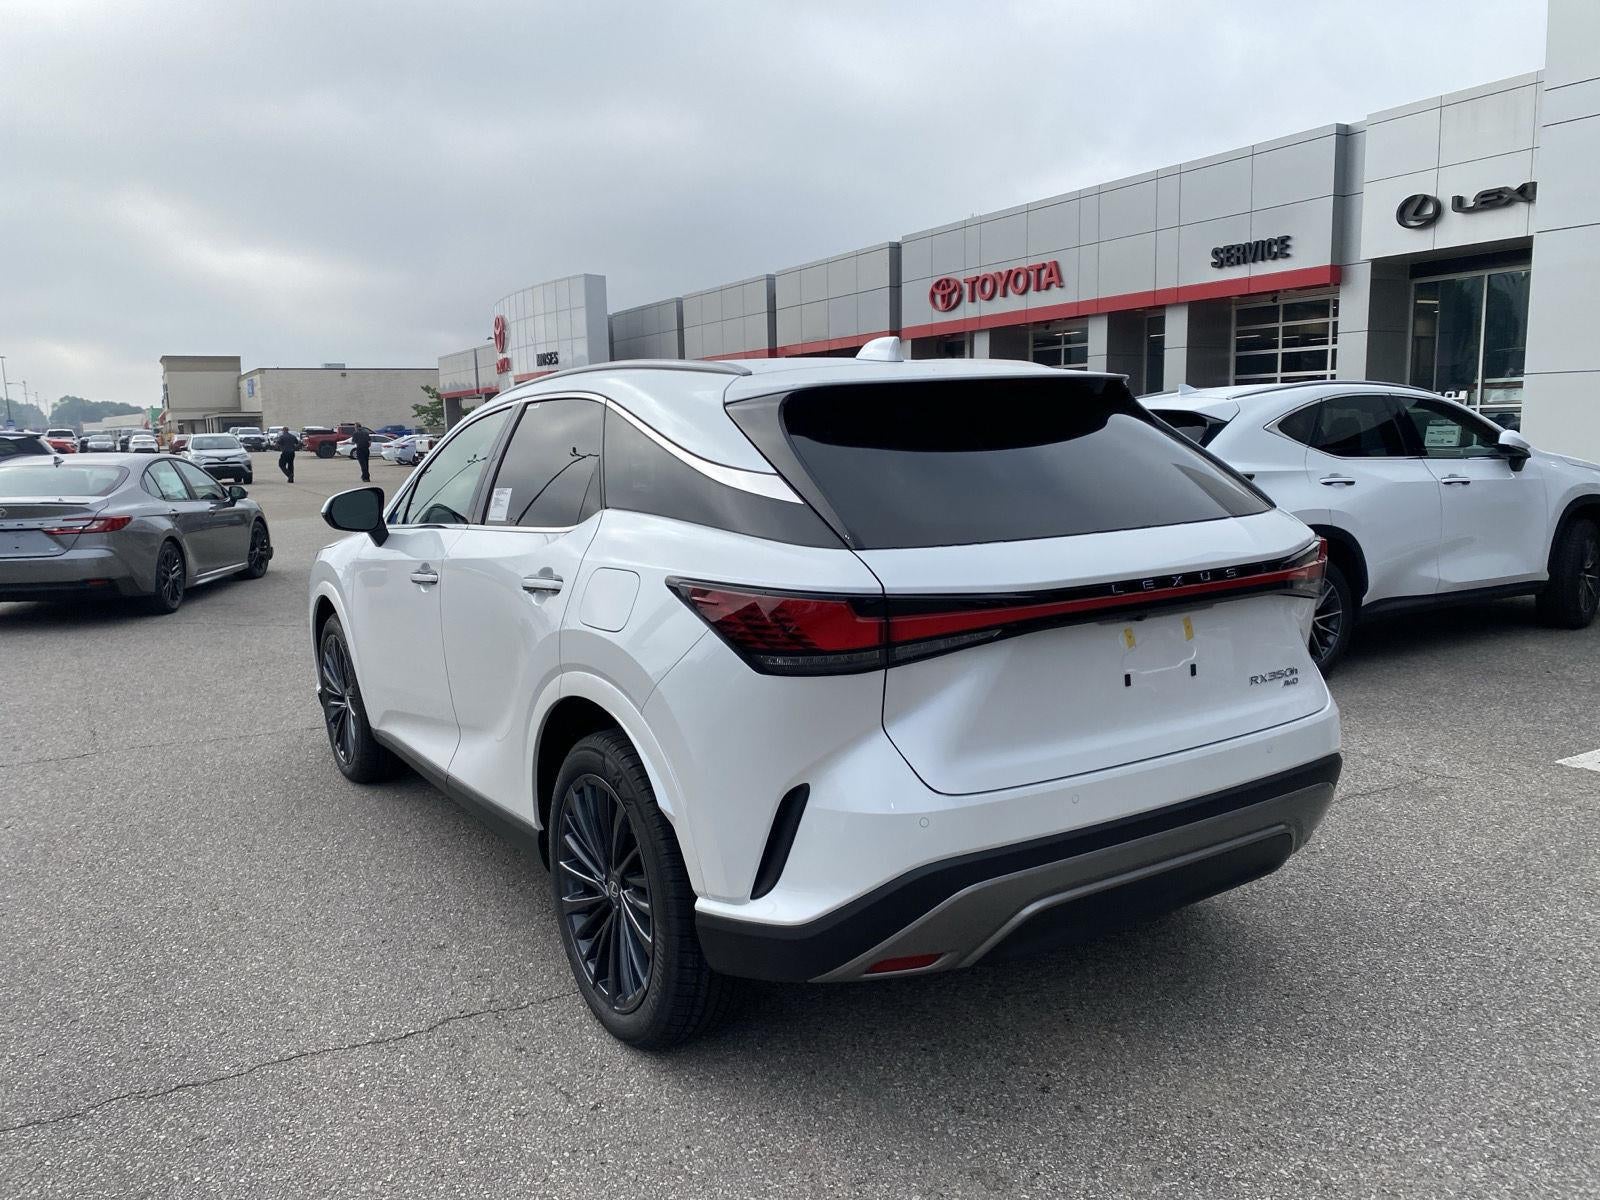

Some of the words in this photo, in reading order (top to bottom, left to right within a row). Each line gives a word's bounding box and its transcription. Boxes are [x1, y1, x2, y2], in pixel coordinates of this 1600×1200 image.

[1211, 235, 1292, 269] SERVICE
[963, 261, 1063, 303] TOYOTA
[1112, 569, 1239, 594] LEXUS
